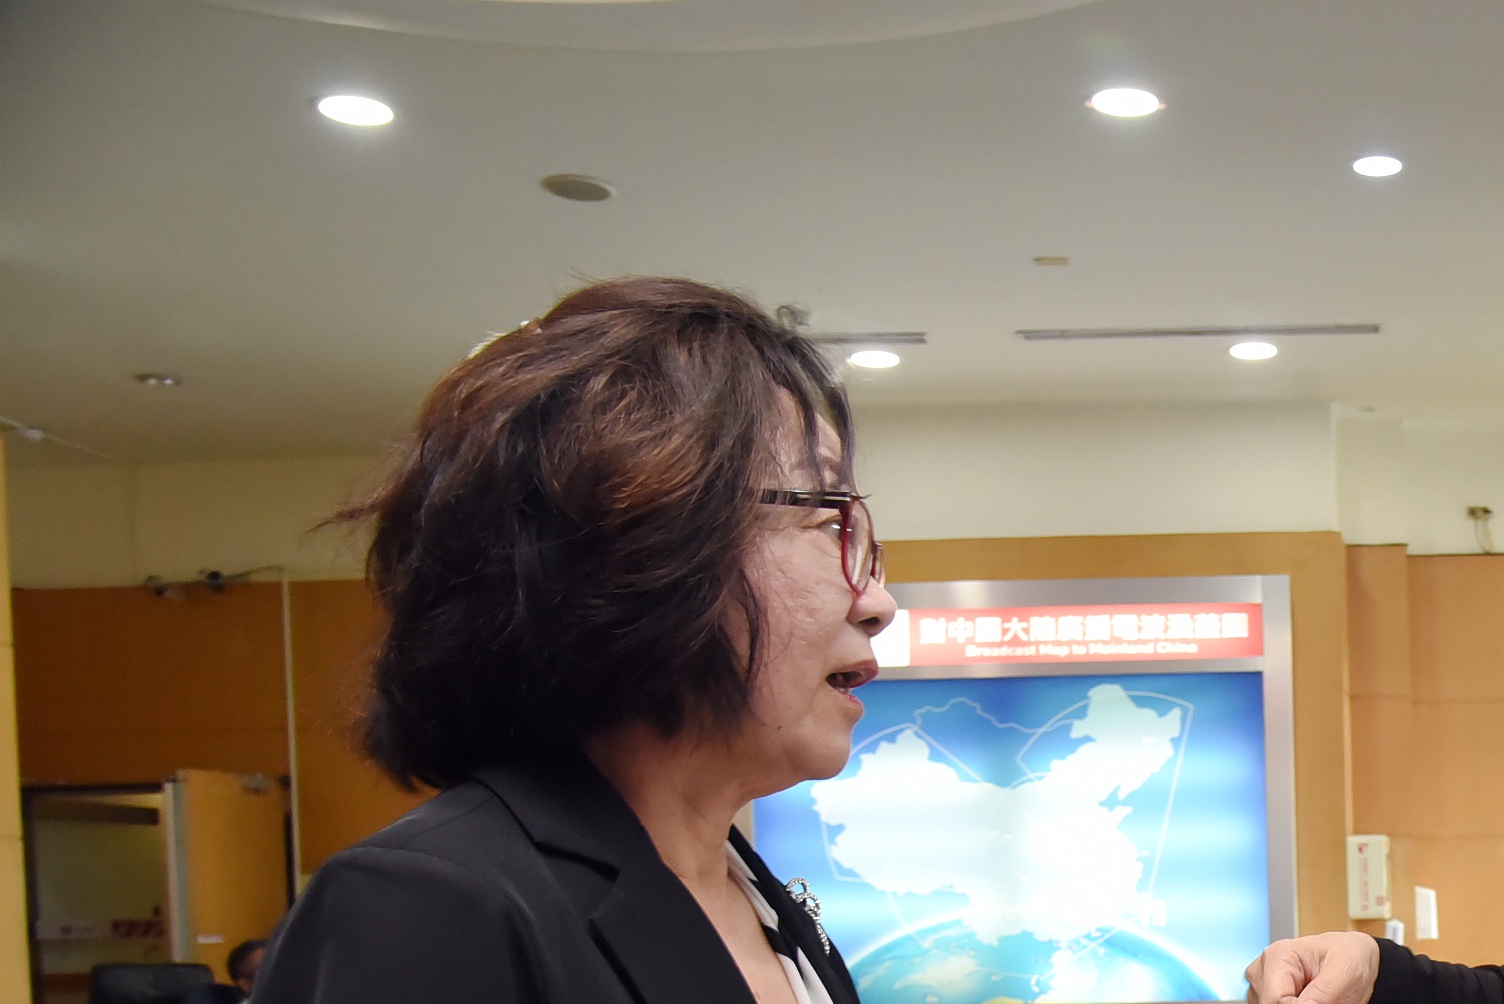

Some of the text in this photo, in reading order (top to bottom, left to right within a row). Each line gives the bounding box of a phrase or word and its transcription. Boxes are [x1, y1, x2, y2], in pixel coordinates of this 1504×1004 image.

[965, 640, 1198, 658] Broadcast Map to Mainland China
